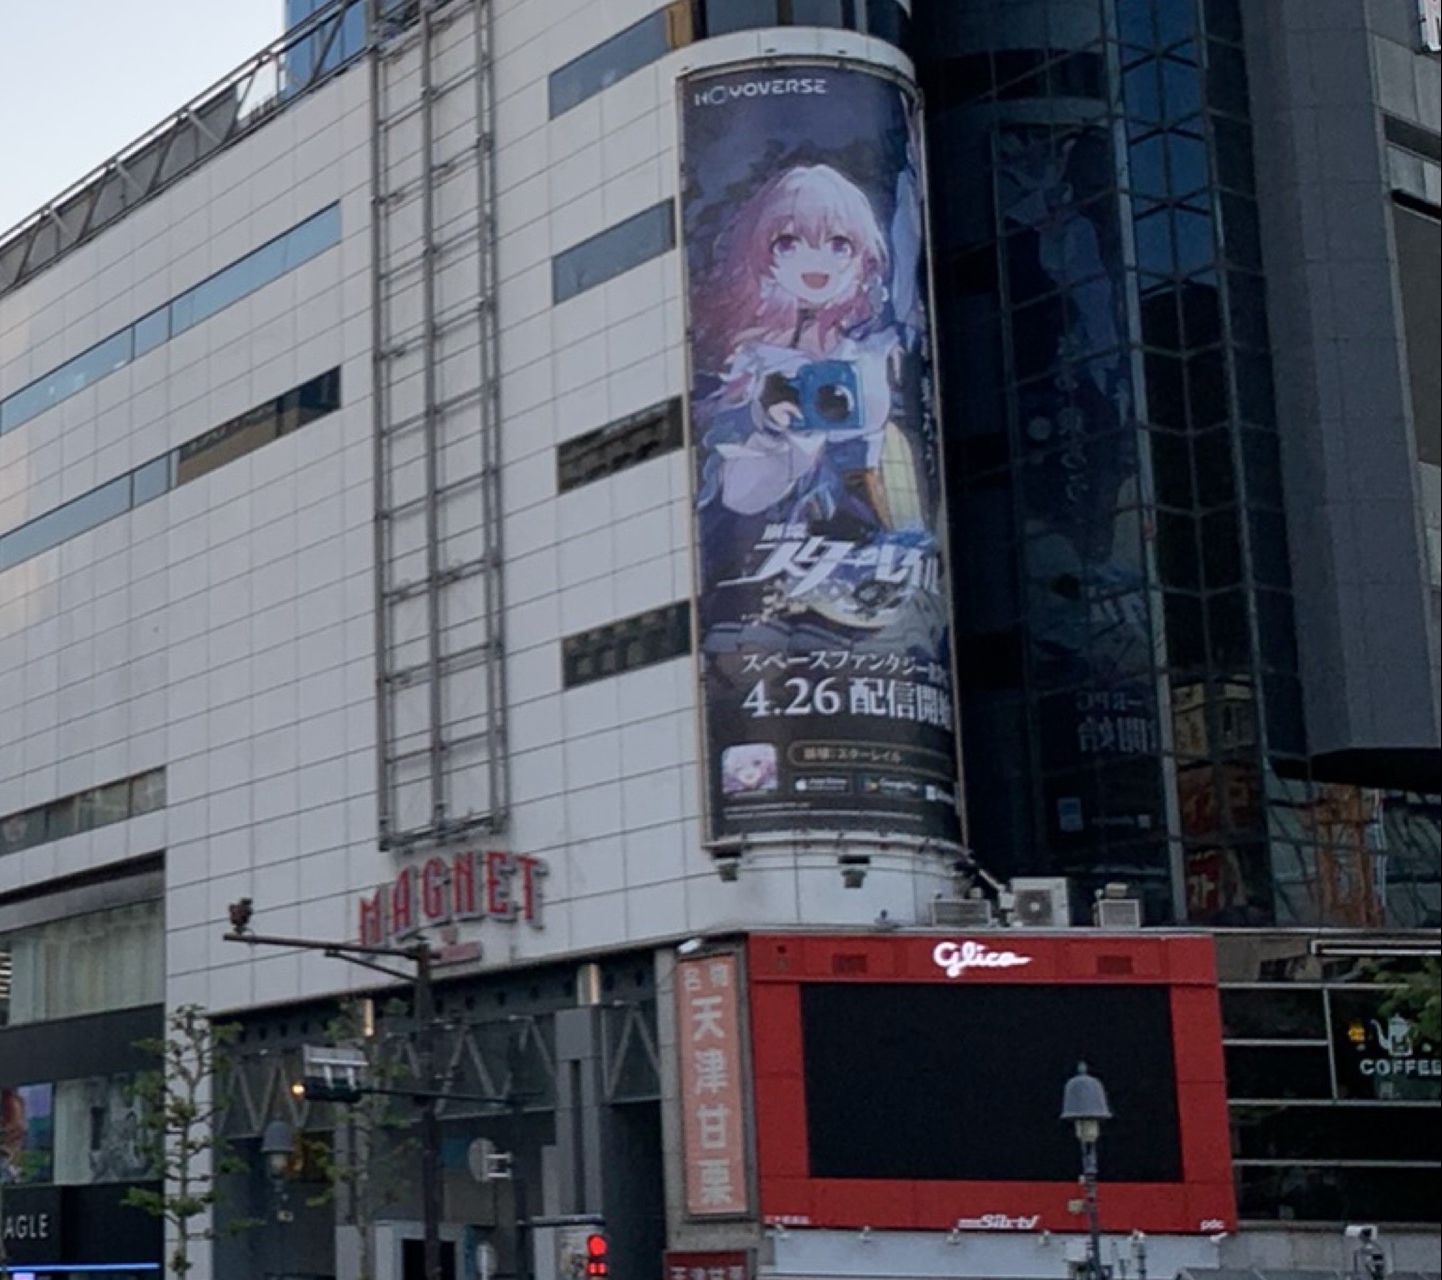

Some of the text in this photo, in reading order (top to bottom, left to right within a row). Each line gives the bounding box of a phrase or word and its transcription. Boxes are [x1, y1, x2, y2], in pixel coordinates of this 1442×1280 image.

[693, 77, 830, 107] HOYOVERSE
[741, 676, 842, 719] 4.26
[359, 849, 546, 950] MAGNET
[932, 940, 1034, 979] Glico
[1359, 1057, 1441, 1077] COFFEE
[689, 994, 734, 1207] 天津甘栗
